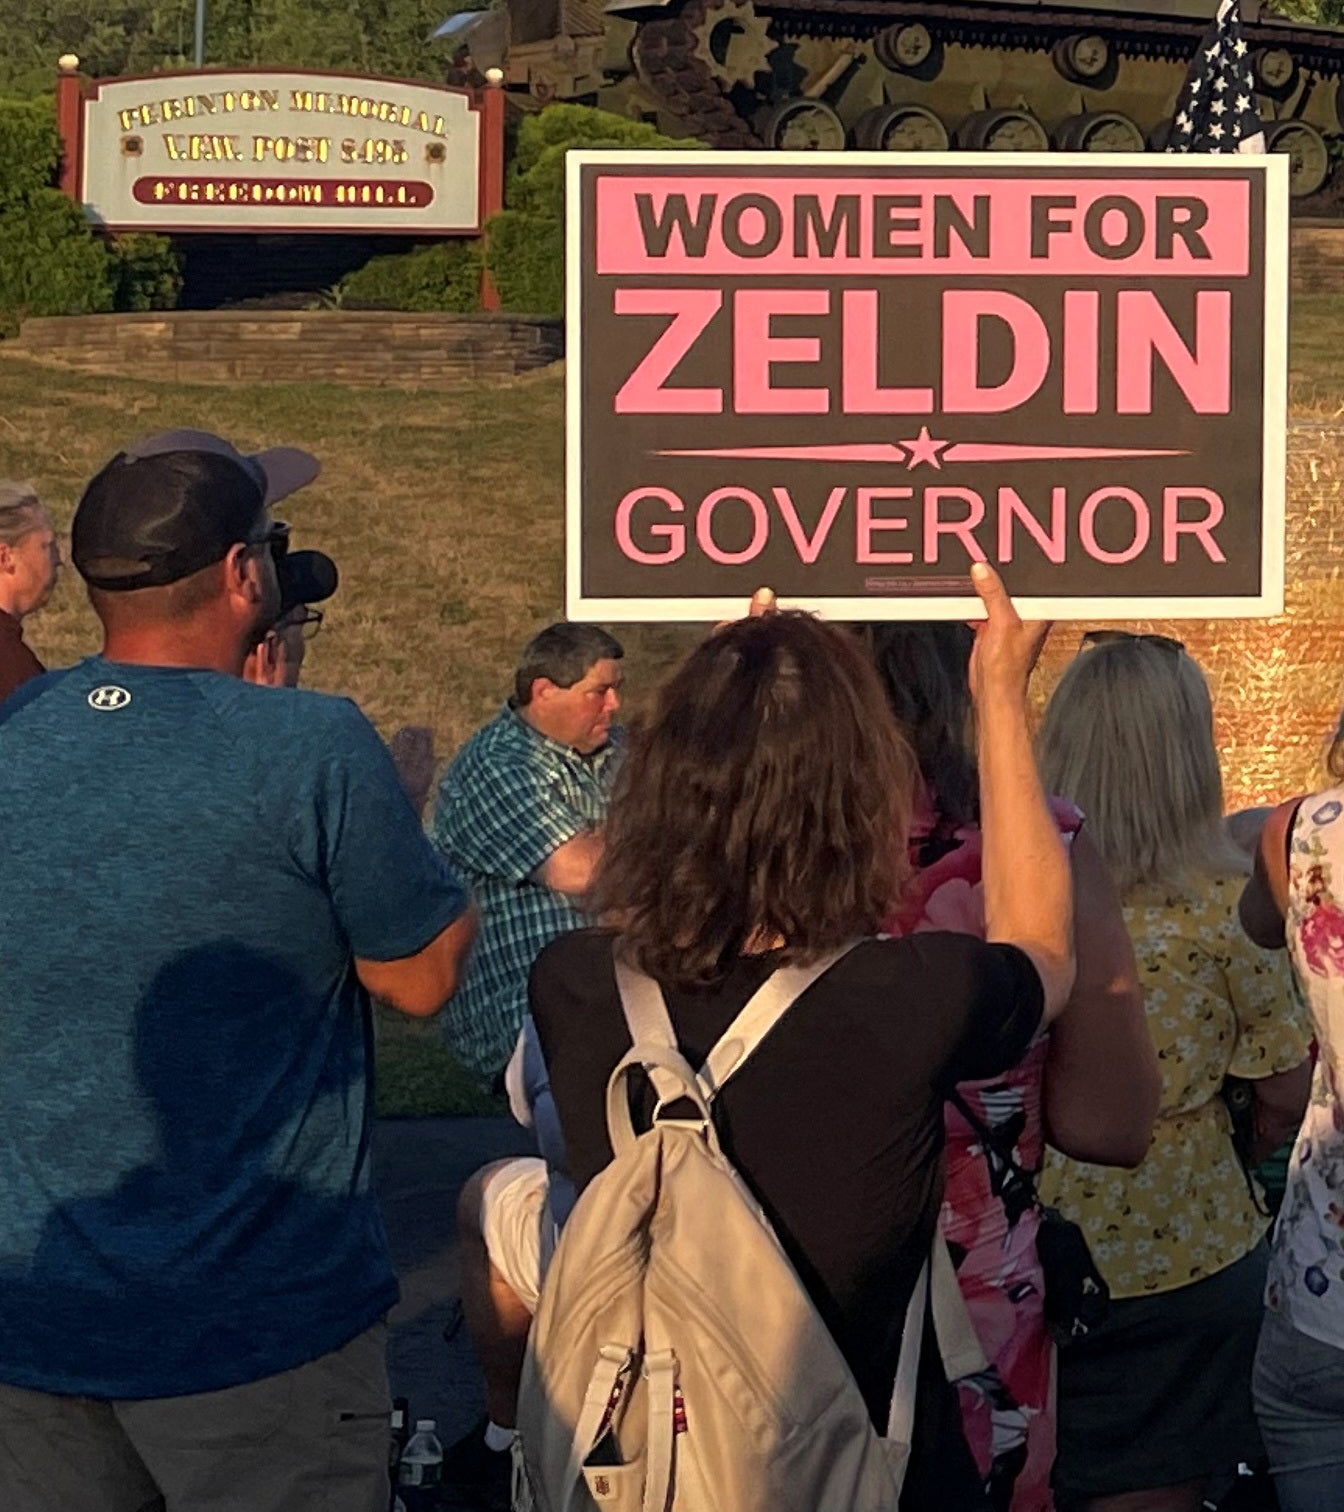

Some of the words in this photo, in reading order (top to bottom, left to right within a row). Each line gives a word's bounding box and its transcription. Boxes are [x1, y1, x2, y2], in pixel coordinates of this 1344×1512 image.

[289, 89, 448, 138] MEMORIAL
[252, 136, 331, 163] POST
[154, 181, 323, 202] FREEDOM
[335, 184, 417, 204] HILL
[634, 192, 992, 259] WOMEN
[1030, 194, 1213, 261] FOR
[612, 288, 1232, 416] ZELDIN
[613, 485, 1228, 566] GOVERNOR
